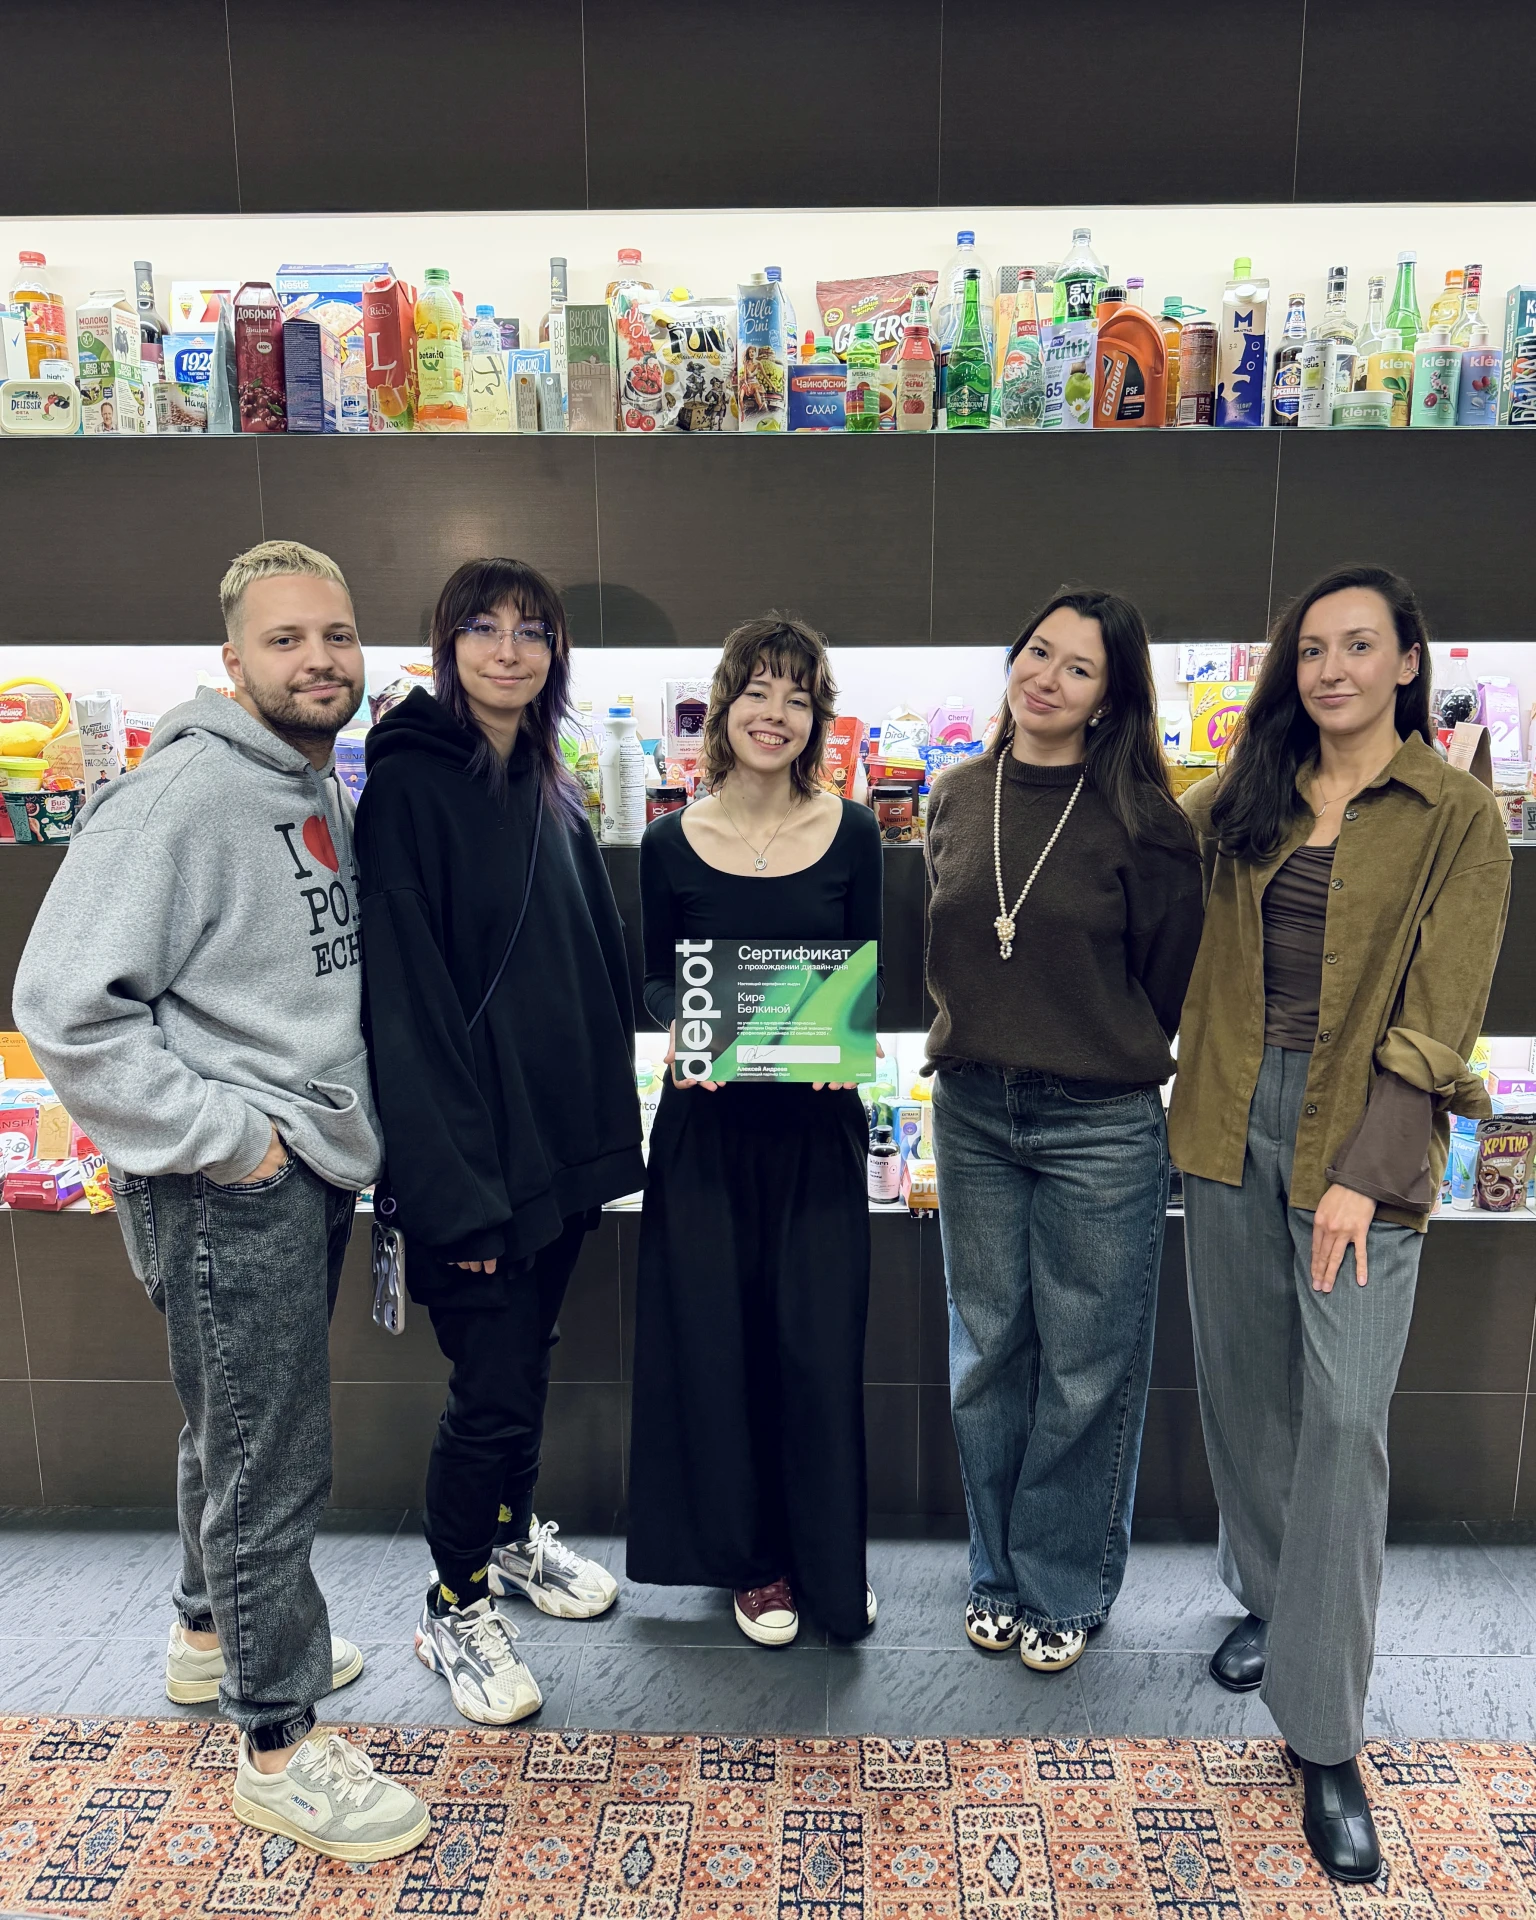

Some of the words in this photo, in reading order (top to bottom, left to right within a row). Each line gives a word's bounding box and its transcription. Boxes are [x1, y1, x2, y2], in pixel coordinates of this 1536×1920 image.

[236, 307, 277, 322] Добрый
[739, 299, 773, 319] Villa
[79, 316, 109, 325] МОЛОКО
[744, 318, 769, 335] Dini
[569, 328, 606, 347] ВЫСОКО
[796, 377, 848, 389] Чайкофский
[1503, 359, 1512, 391] 2010
[570, 379, 592, 391] КЕФИР
[905, 380, 924, 388] ФЕРМА
[1046, 381, 1063, 399] 65
[1125, 386, 1139, 396] PSF
[805, 404, 837, 415] САХАР
[948, 714, 969, 722] Cherry
[884, 731, 906, 740] Dirol
[274, 822, 313, 880] I
[311, 930, 363, 977] ECH
[738, 945, 851, 963] Сертификат
[744, 964, 800, 972] прохождении
[800, 963, 849, 972] дизайн-дня
[737, 992, 766, 1004] Кире
[675, 939, 722, 1082] depot
[737, 1003, 791, 1014] Белкиной
[1483, 1136, 1529, 1156] ХРУТКА
[290, 1743, 311, 1767] AUTRY
[290, 1793, 311, 1811] AUTRY
